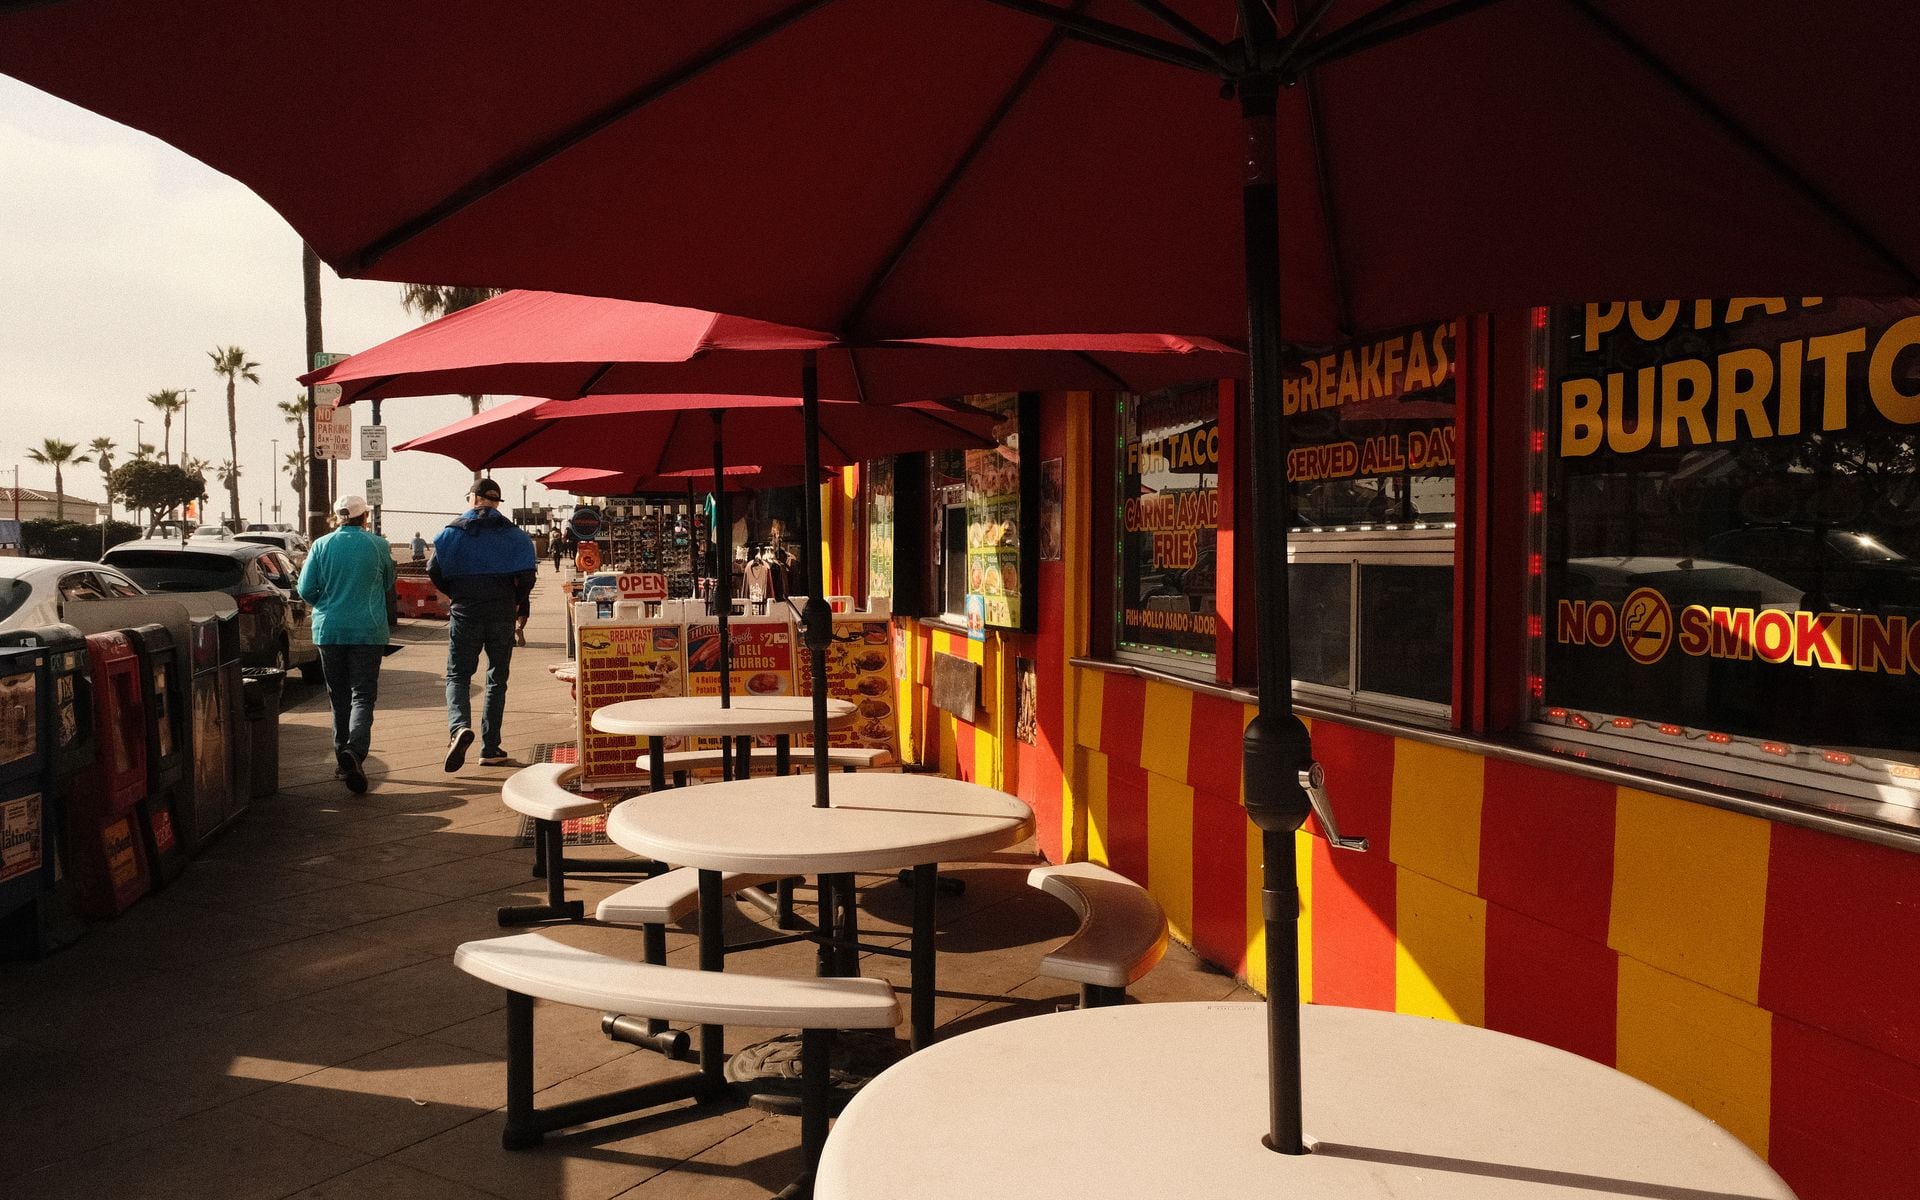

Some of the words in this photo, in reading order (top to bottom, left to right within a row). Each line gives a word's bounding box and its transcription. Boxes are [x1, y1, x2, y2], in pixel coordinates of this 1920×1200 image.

[1283, 321, 1456, 416] BREAKFAS
[318, 410, 331, 421] NO
[317, 423, 349, 434] PARKING
[1127, 439, 1164, 476] FISH
[1287, 441, 1358, 482] SERVED
[1361, 434, 1405, 474] ALL
[1125, 493, 1175, 532] CARNE
[1152, 530, 1198, 569] FRIES
[618, 575, 666, 592] OPEN
[1126, 609, 1139, 626] FISH
[1143, 610, 1164, 629] POLLO
[1165, 612, 1188, 632] ASADO
[1558, 600, 1616, 647] NO
[610, 629, 652, 642] BREAKFAST
[616, 643, 630, 656] ALL
[632, 643, 646, 655] DAY
[739, 645, 761, 656] DELI
[2, 829, 31, 848] latino
